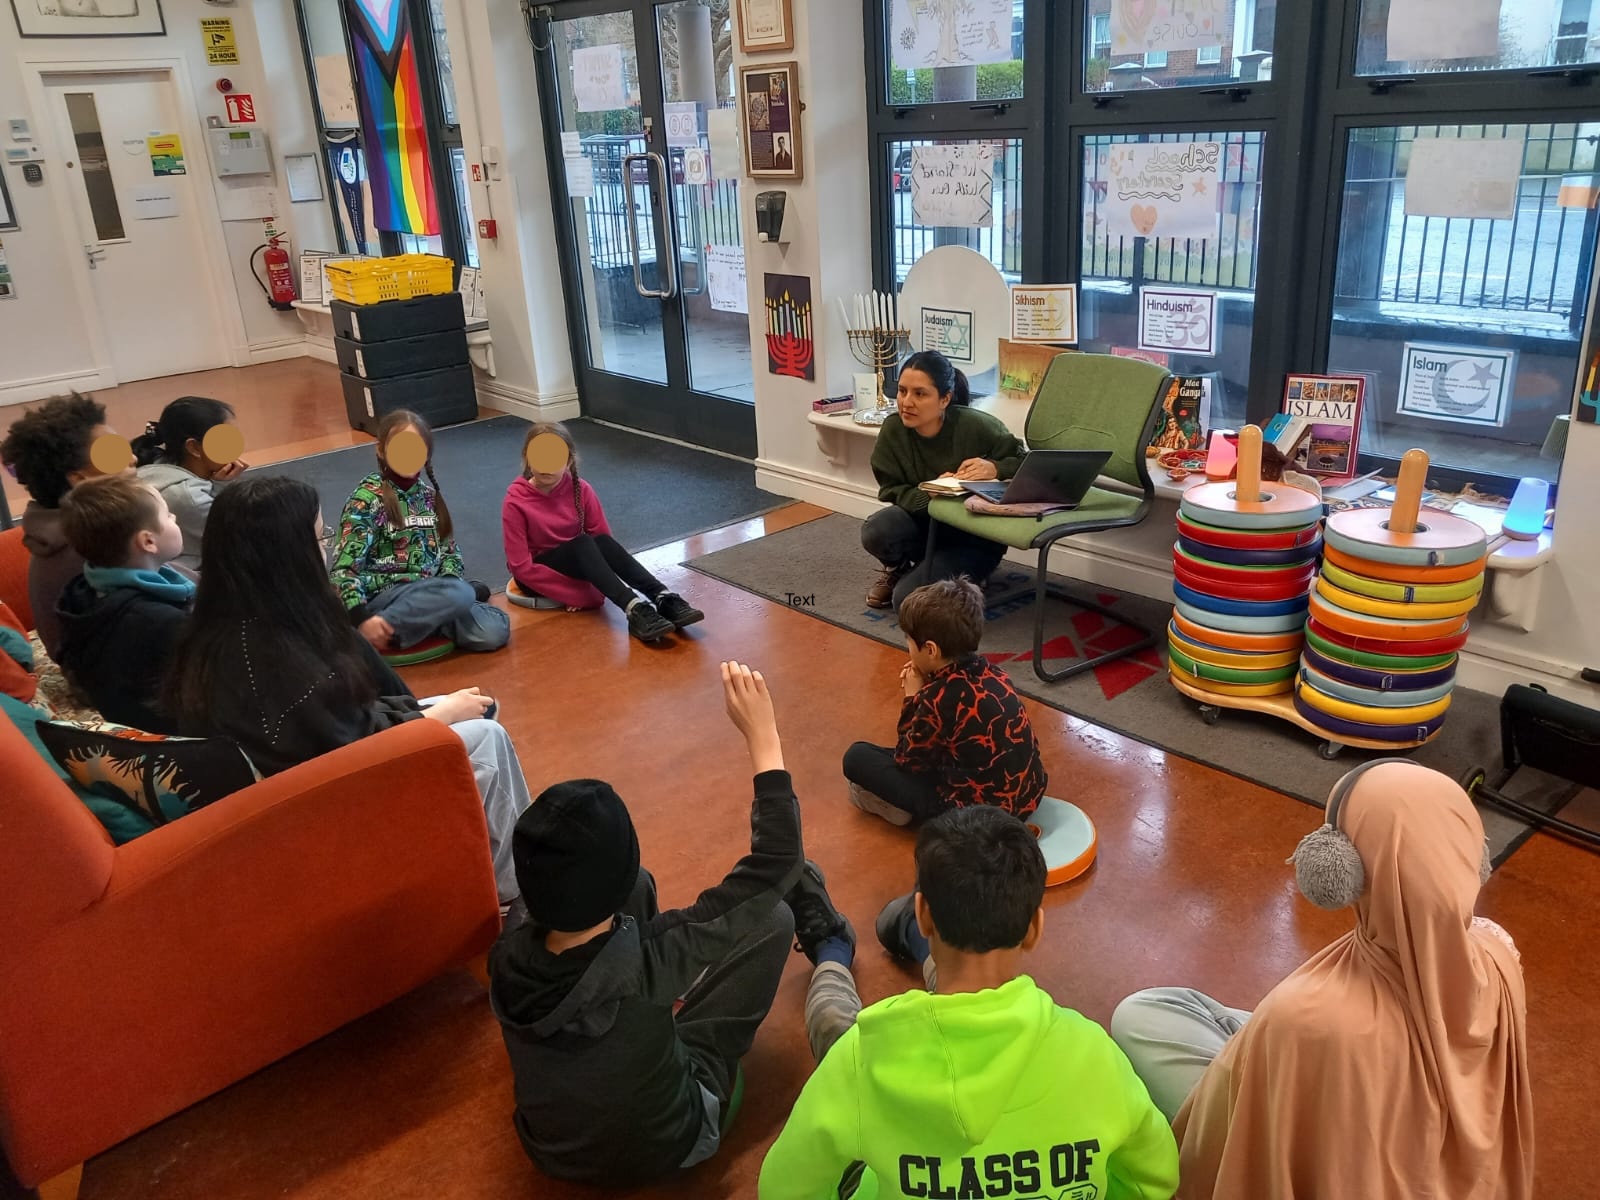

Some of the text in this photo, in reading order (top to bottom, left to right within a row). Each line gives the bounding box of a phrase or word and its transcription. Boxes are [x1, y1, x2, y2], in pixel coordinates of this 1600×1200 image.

[1015, 295, 1045, 306] Sikhism
[1147, 299, 1193, 313] Hinduism
[924, 314, 953, 327] Judaism
[1413, 355, 1448, 373] Islam
[1287, 400, 1353, 419] ISLAM
[899, 1139, 1101, 1200] CLASS OF
